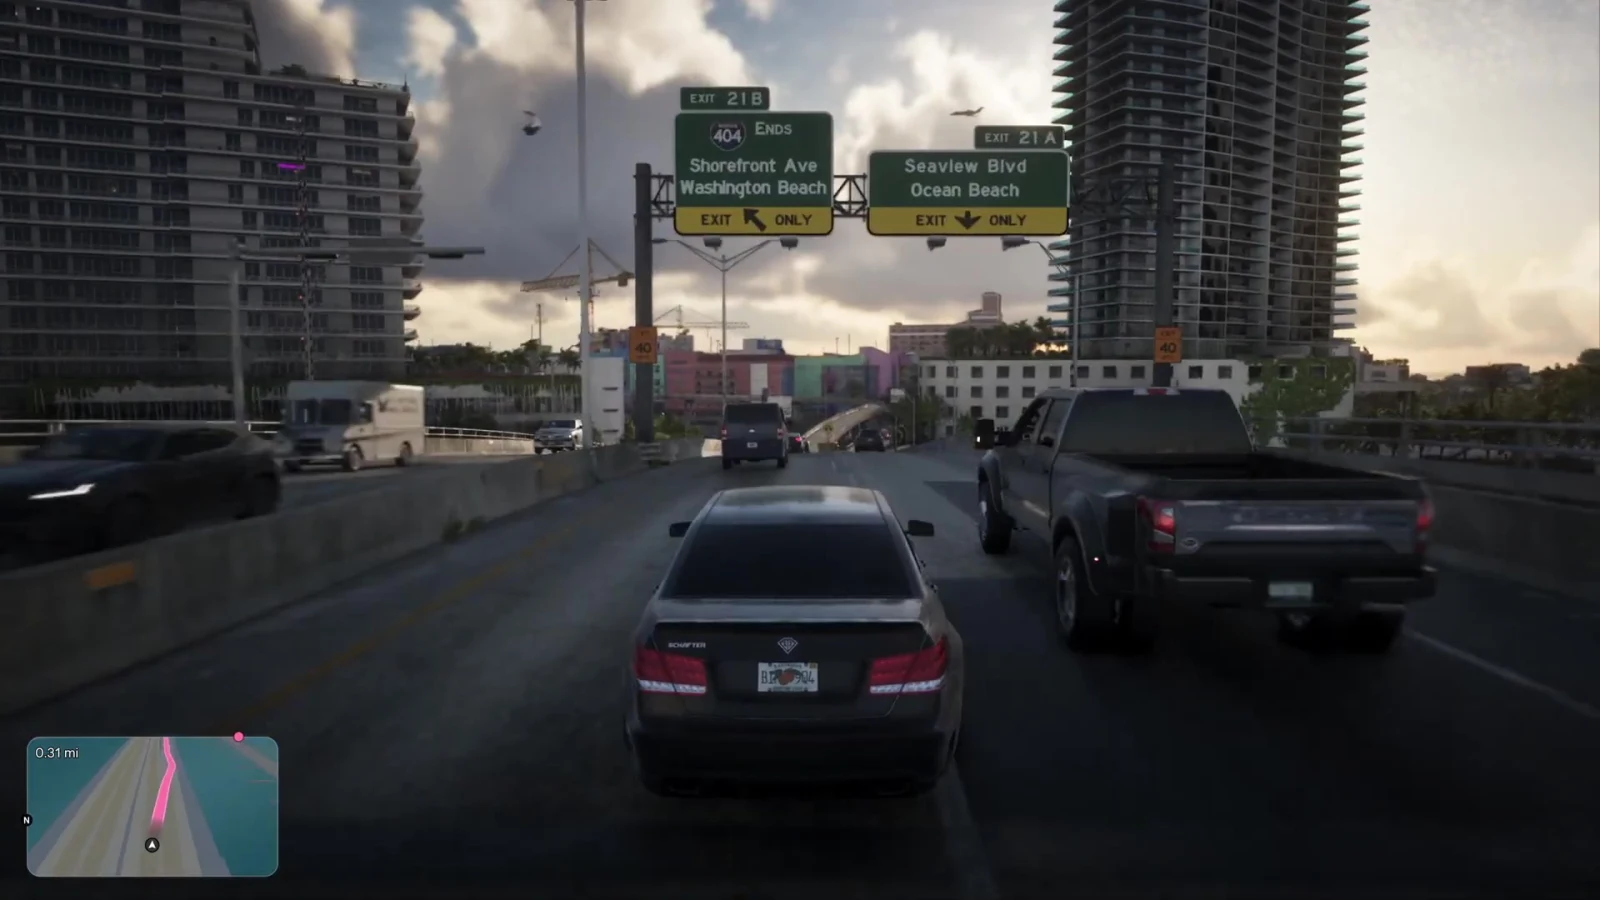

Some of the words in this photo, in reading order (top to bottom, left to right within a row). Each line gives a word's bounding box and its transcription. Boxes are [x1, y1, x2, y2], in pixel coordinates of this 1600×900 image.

[690, 93, 715, 103] EXIT
[727, 92, 763, 106] 21B
[713, 129, 742, 143] 404
[984, 133, 1009, 143] EXIT
[689, 158, 776, 173] Shorefront
[784, 158, 818, 173] Ave
[905, 158, 978, 173] Seaview
[988, 158, 1027, 173] Blvd
[680, 180, 771, 198] Washington
[778, 180, 827, 195] Beach
[911, 182, 961, 197] Ocean
[969, 182, 1020, 197] Beach
[701, 214, 732, 225] EXIT
[775, 214, 812, 226] ONLY
[916, 215, 946, 226] EXIT
[989, 215, 1027, 226] ONLY
[635, 342, 652, 353] 40
[1160, 342, 1177, 353] 40
